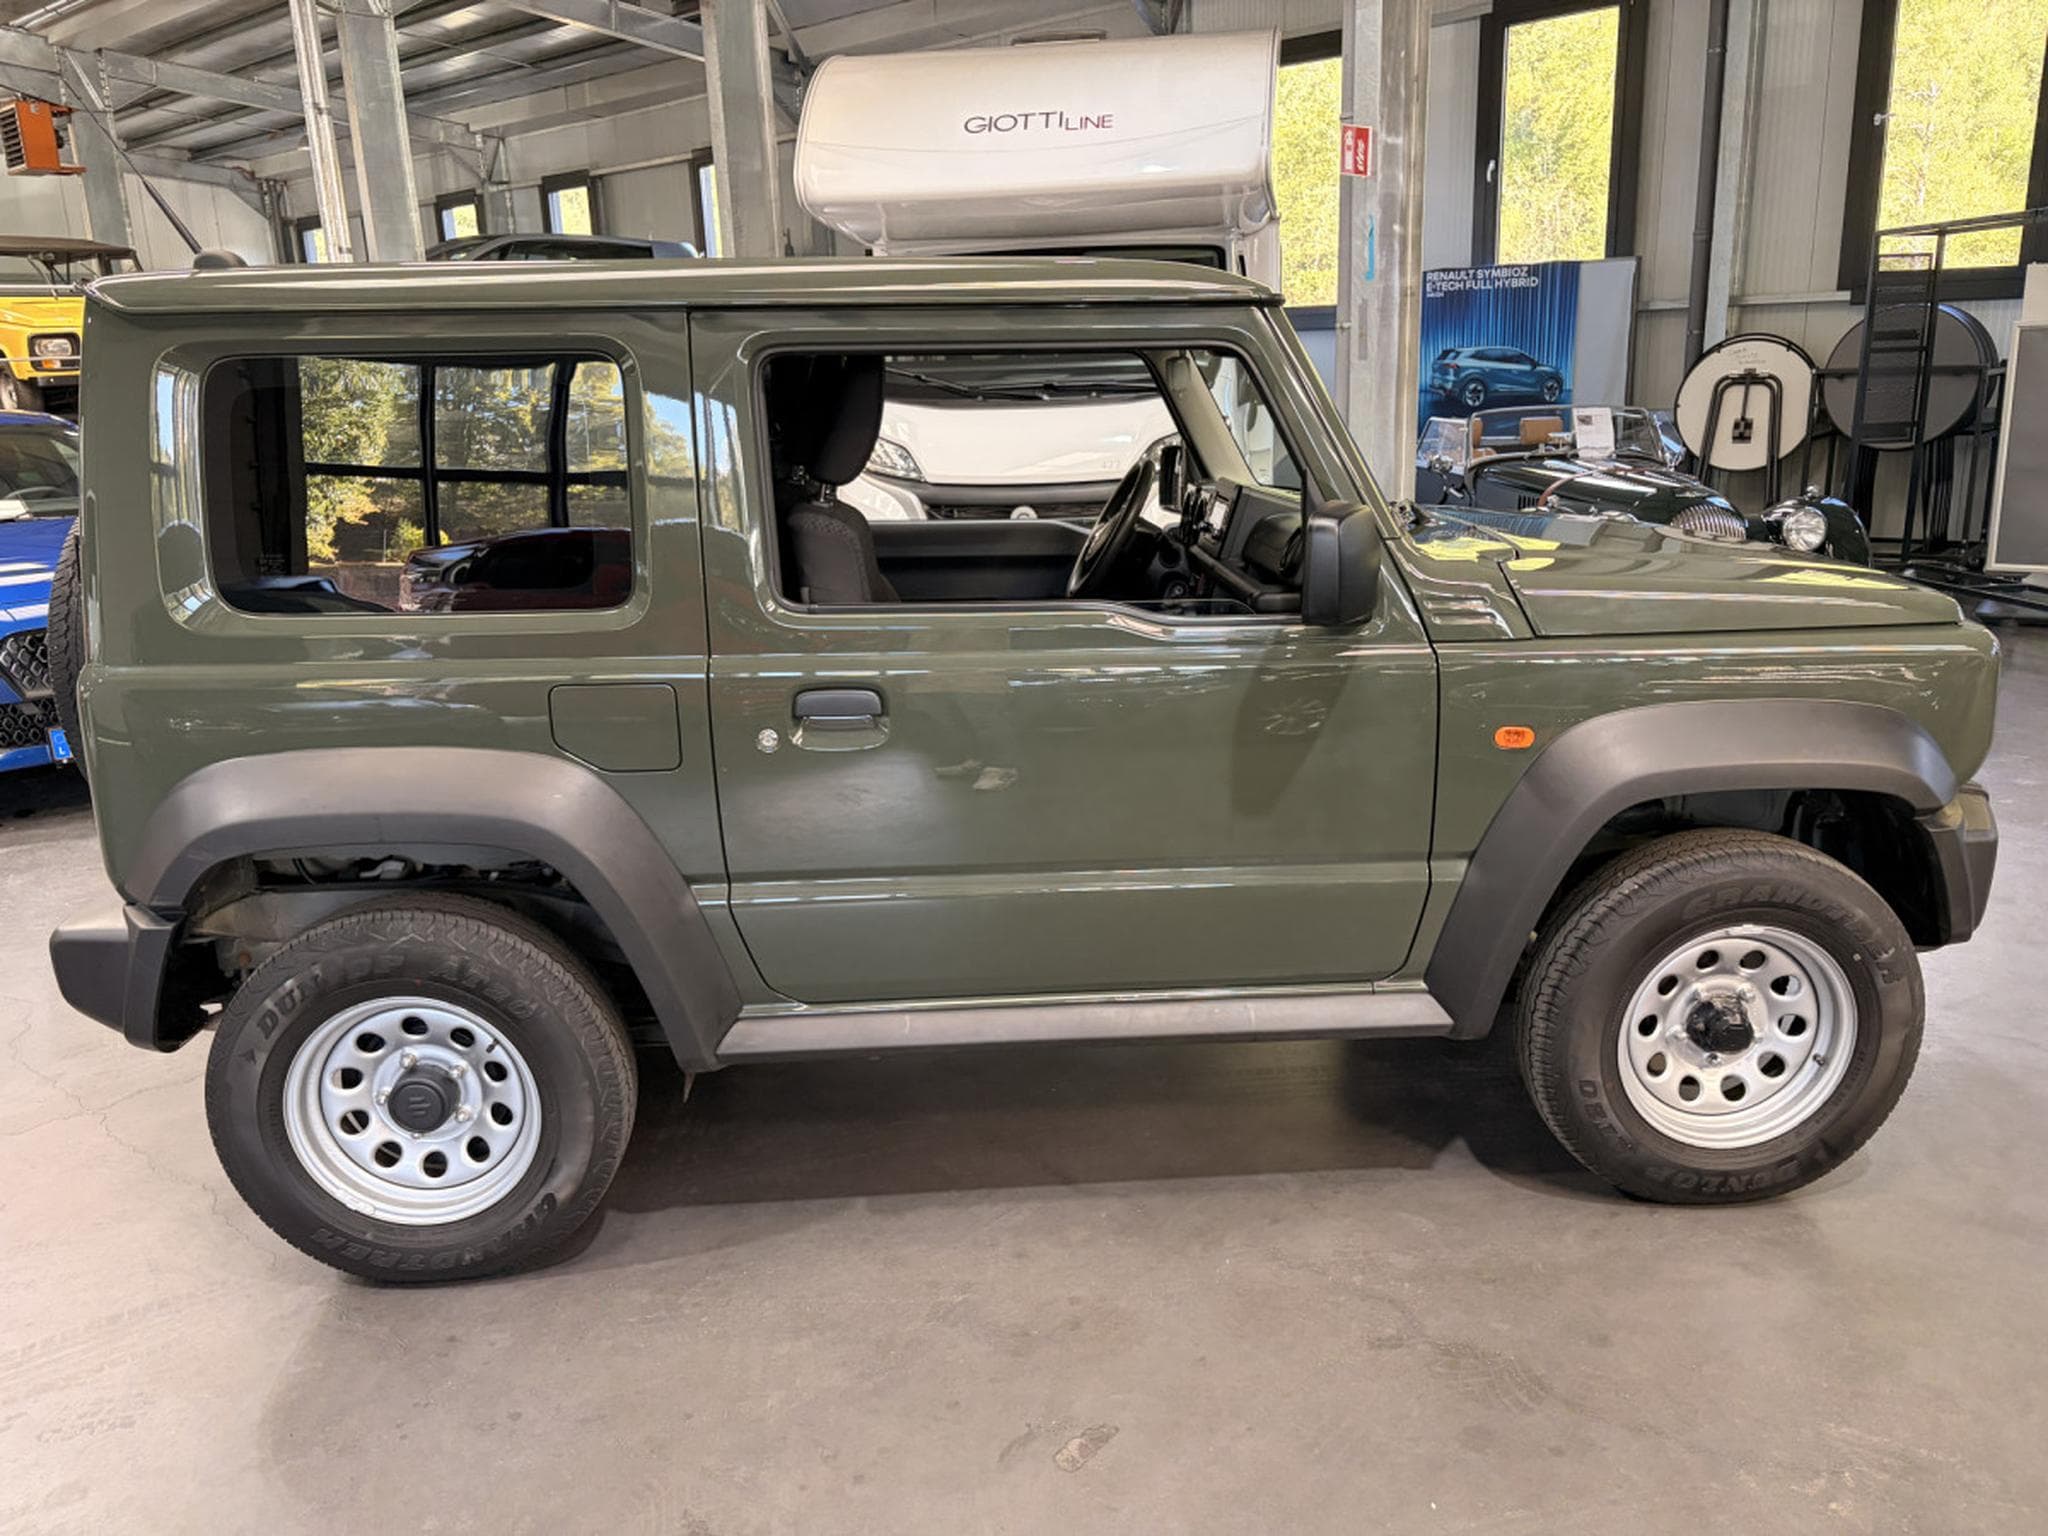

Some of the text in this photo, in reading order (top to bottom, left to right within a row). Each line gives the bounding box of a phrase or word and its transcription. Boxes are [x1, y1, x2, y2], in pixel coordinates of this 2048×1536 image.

[964, 111, 1113, 134] GIOTTILINE
[1426, 266, 1529, 281] RENAULT SYMBIOZ
[1426, 277, 1539, 292] E-TECH FULL HYBRID
